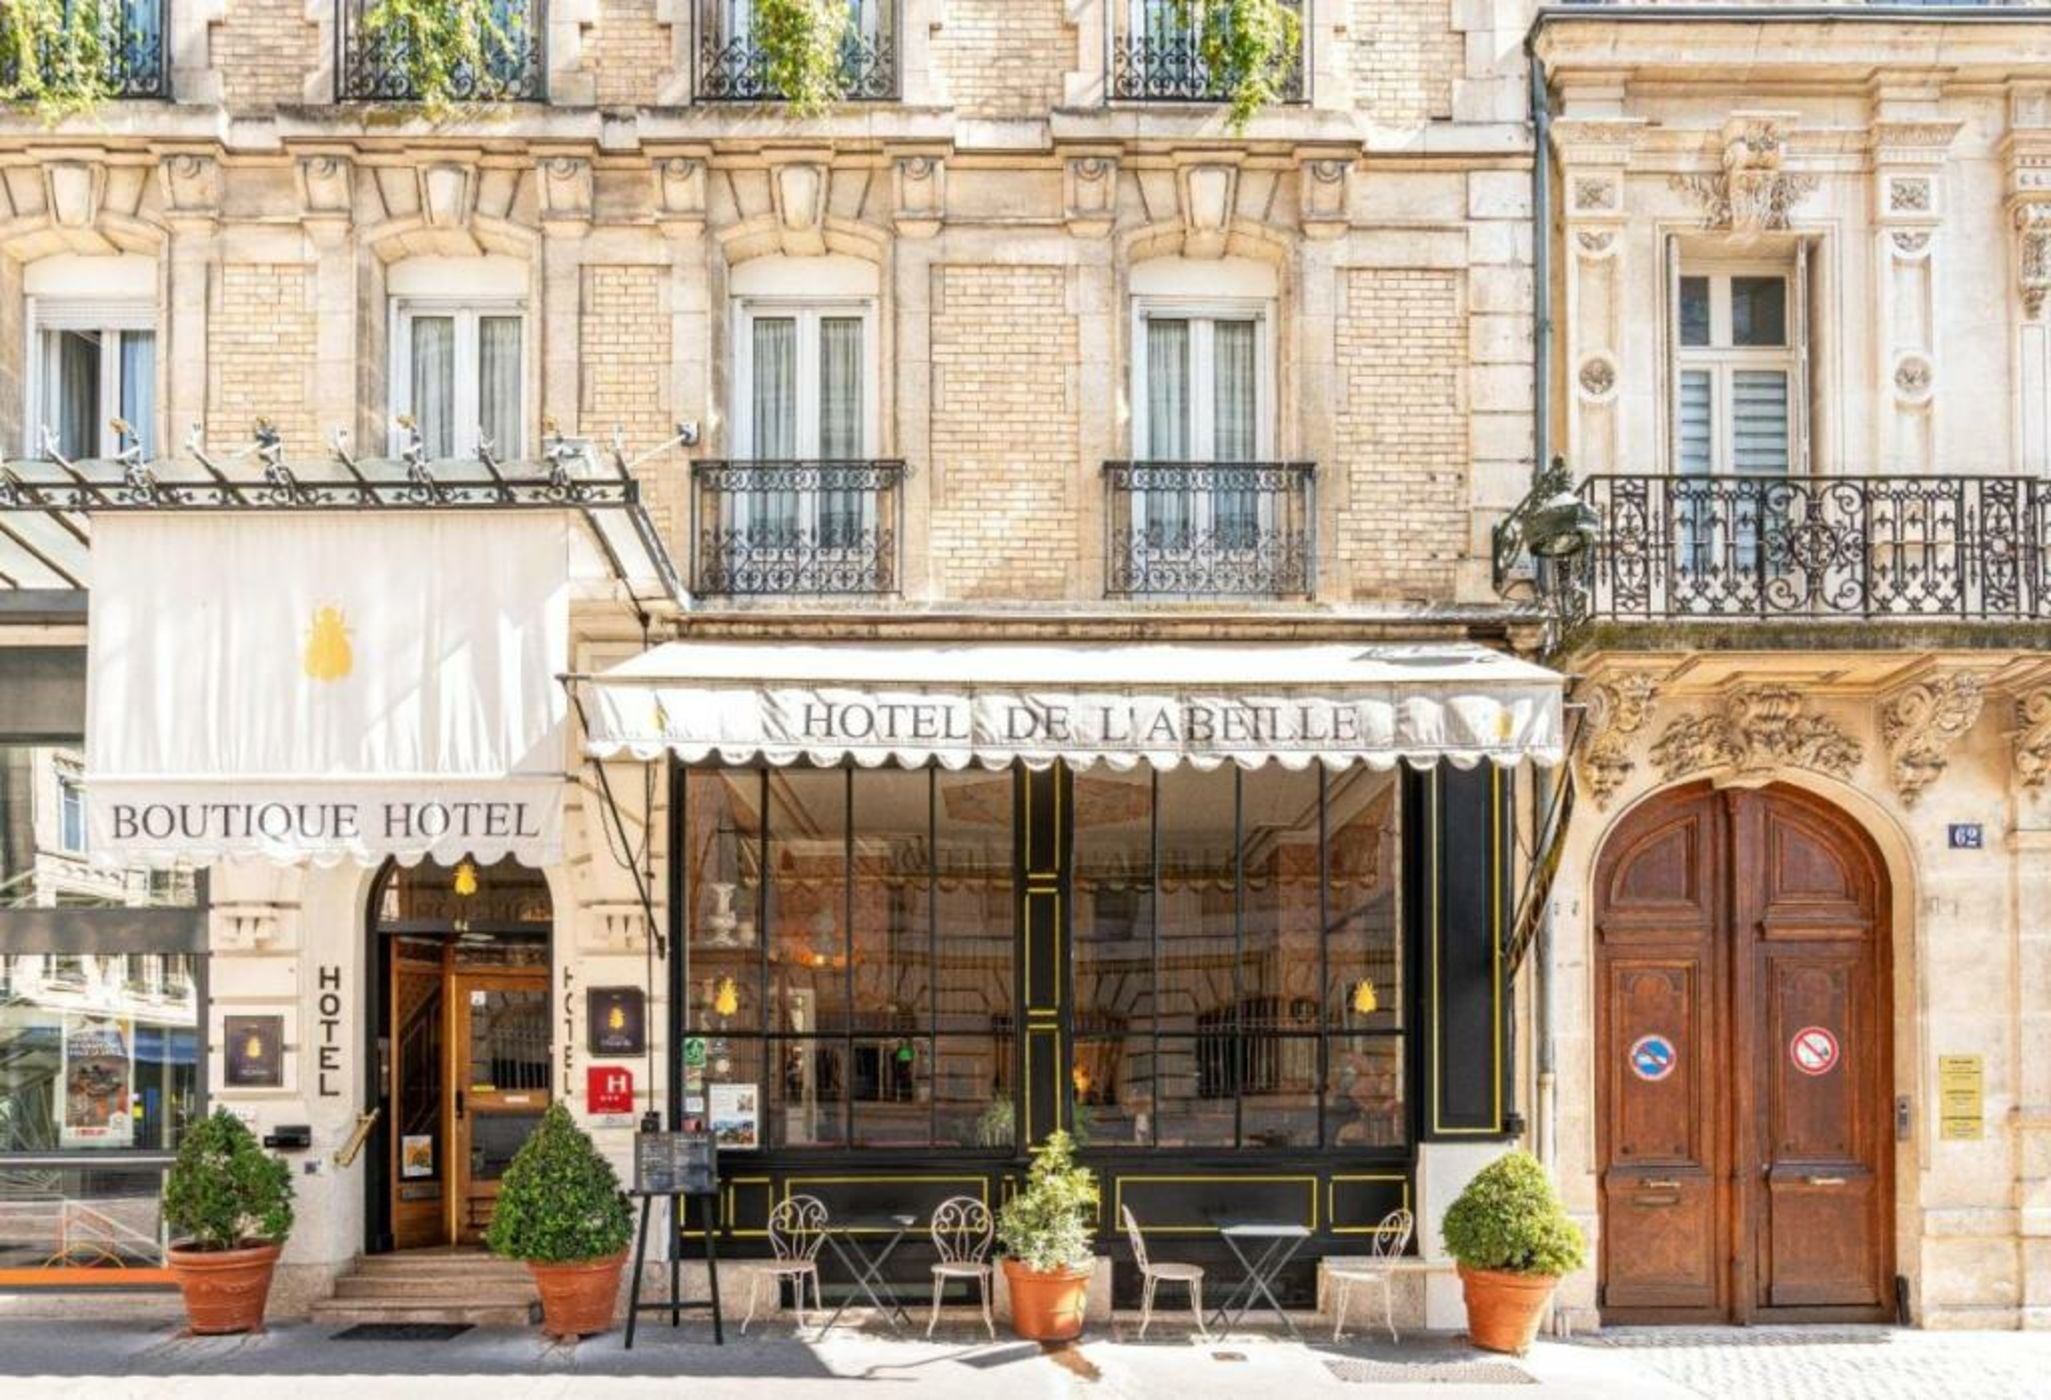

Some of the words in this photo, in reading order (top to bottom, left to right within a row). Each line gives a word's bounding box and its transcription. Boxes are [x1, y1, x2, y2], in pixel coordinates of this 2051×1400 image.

[803, 703, 968, 739] HOTEL
[1007, 705, 1070, 740] DE
[1099, 705, 1358, 742] L'ABEILLE
[112, 802, 360, 843] BOUTIQUE
[384, 802, 540, 838] HOTEL
[1954, 827, 1978, 846] 62
[319, 965, 341, 1096] HOTEL
[606, 1074, 628, 1094] H
